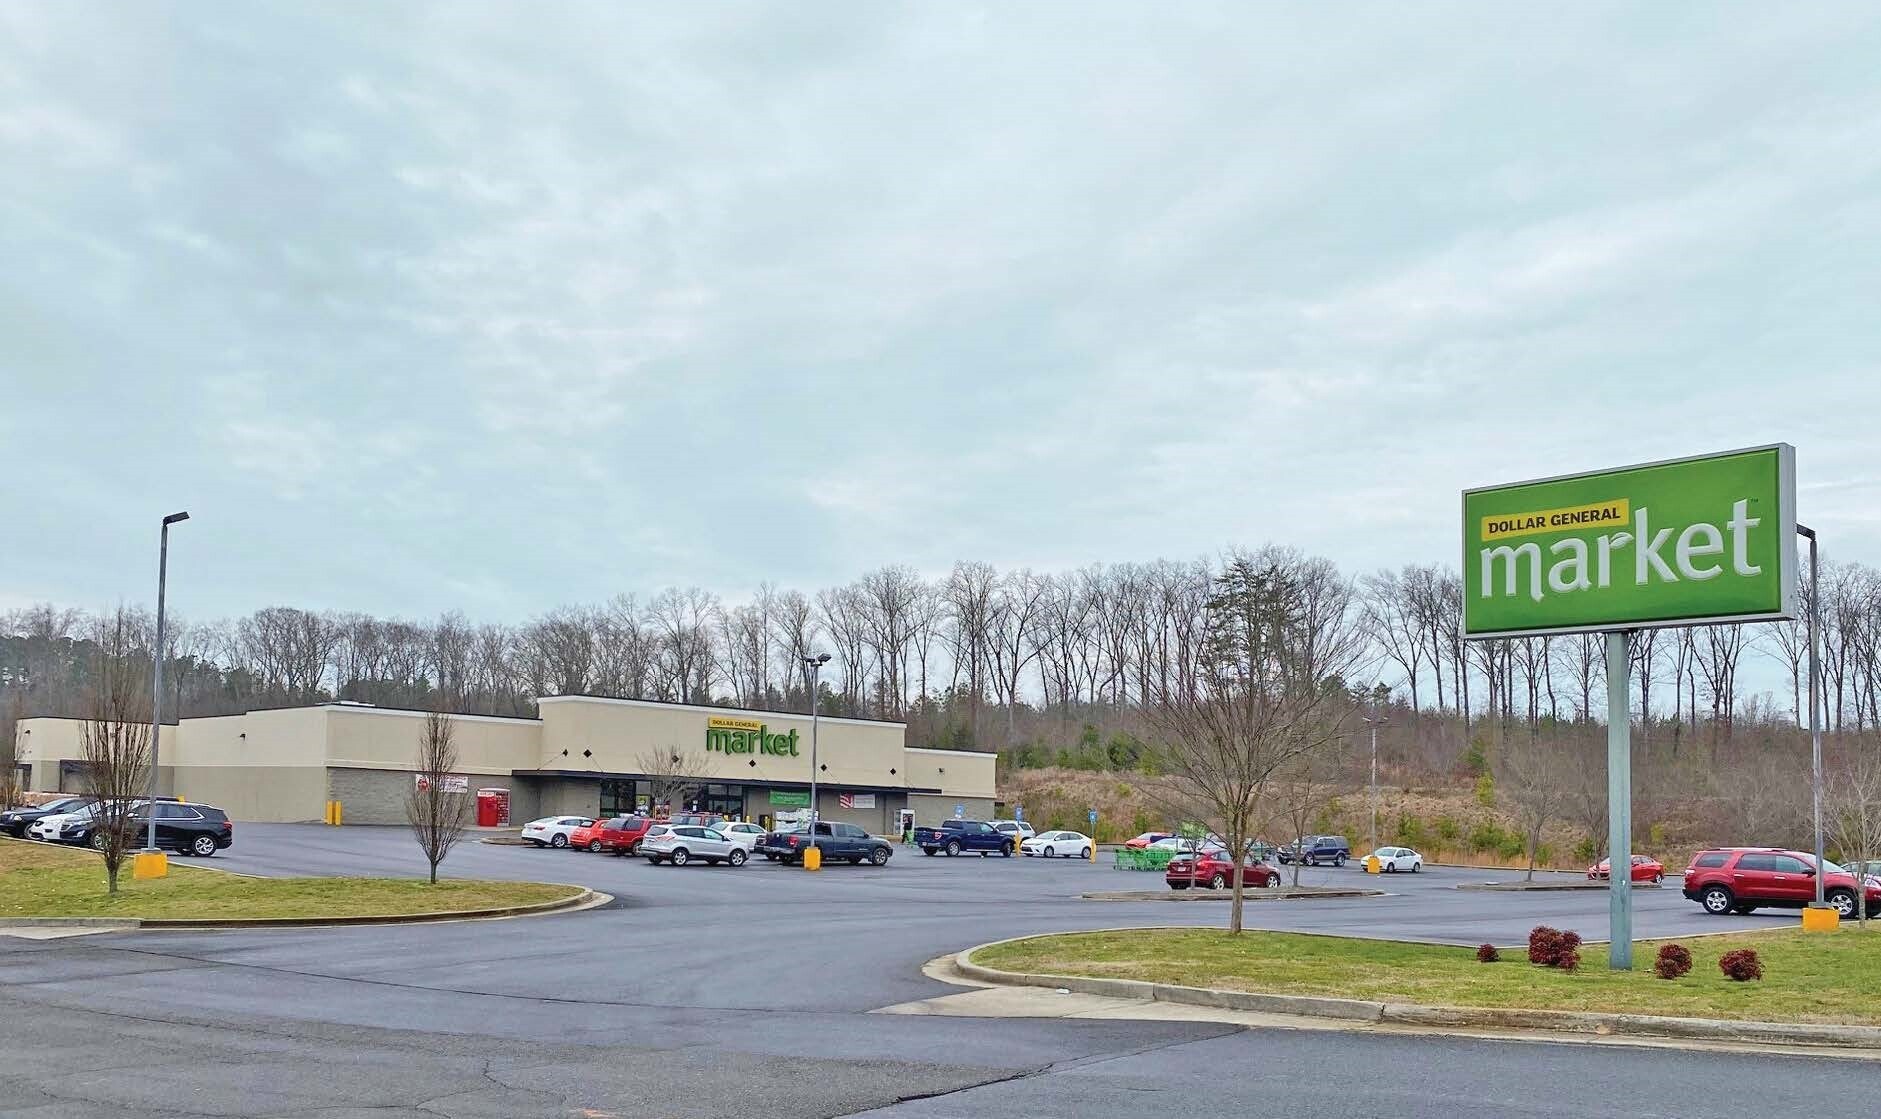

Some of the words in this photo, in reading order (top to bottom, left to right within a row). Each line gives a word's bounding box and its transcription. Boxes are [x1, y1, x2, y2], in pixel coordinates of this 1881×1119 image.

[1489, 516, 1545, 534] DOLLAR
[1551, 507, 1620, 526] GENERAL
[1480, 499, 1762, 602] market
[712, 719, 734, 727] DOLLAR
[706, 725, 800, 757] market
